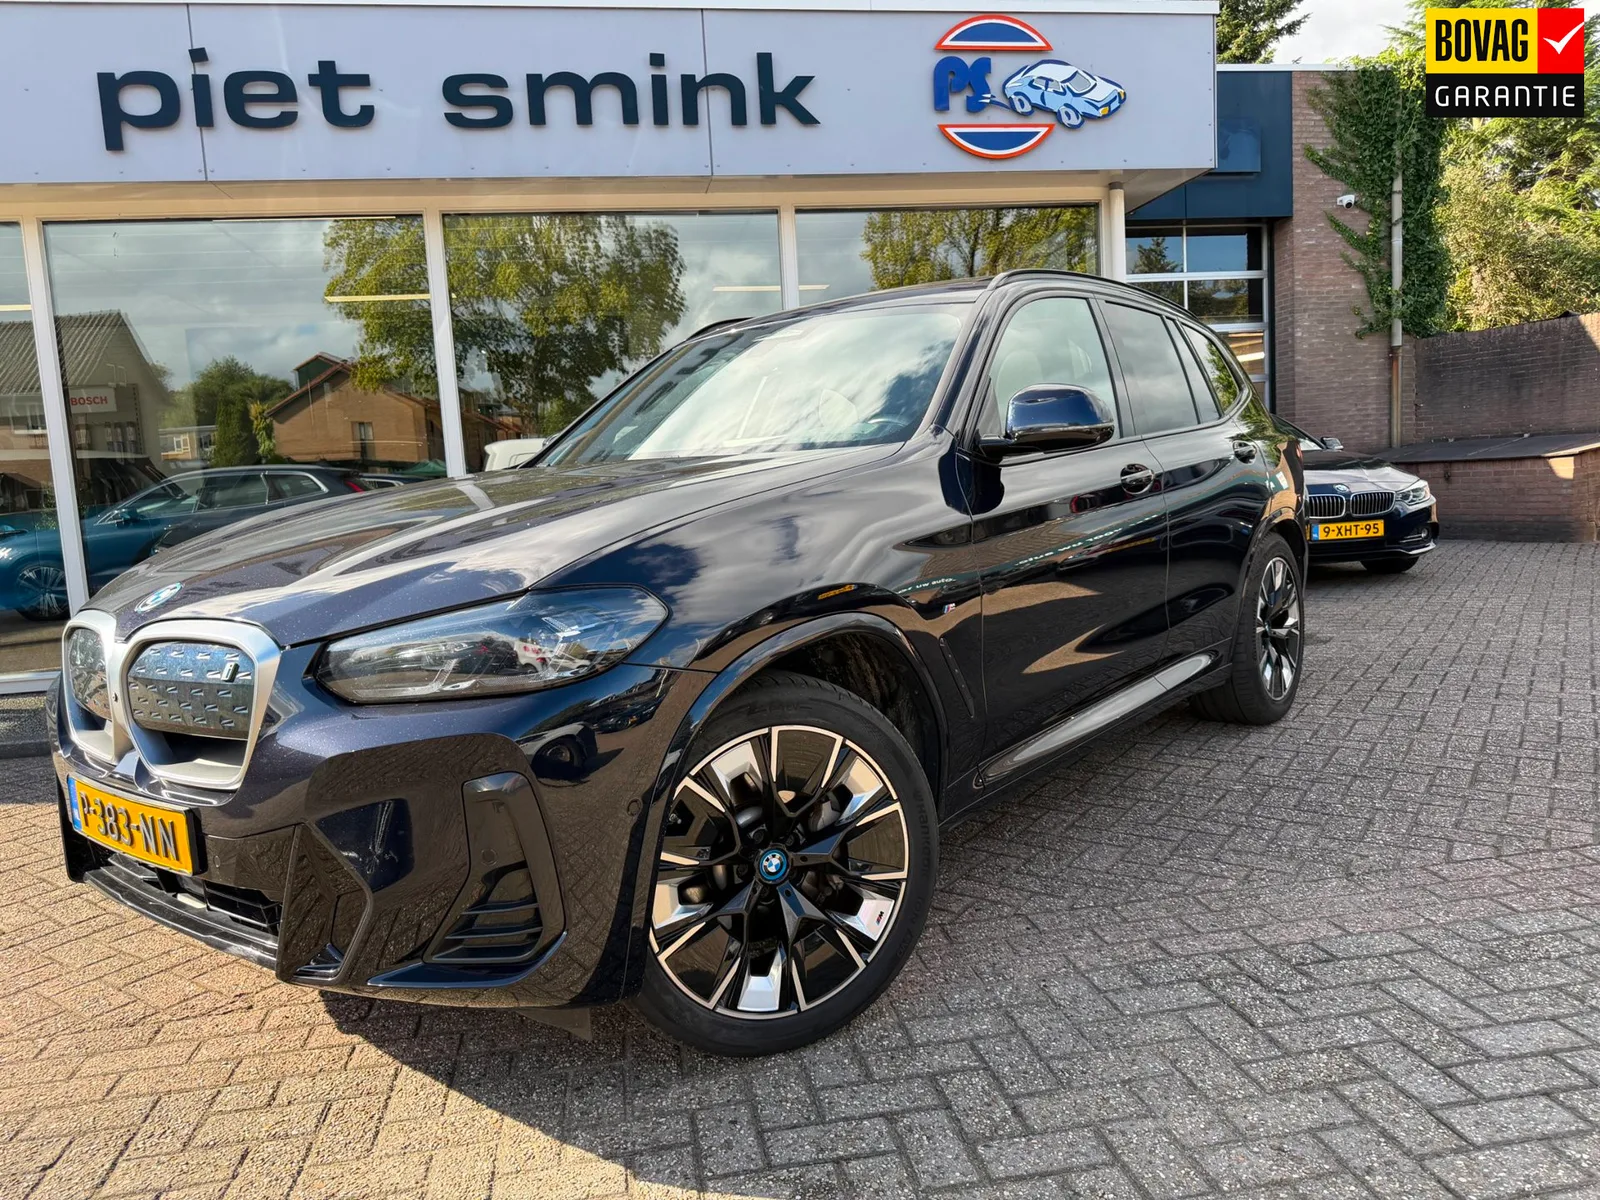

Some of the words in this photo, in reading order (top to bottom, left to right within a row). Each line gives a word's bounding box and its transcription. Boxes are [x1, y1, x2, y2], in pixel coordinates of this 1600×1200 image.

[97, 47, 375, 151] piet
[442, 52, 821, 129] smink
[933, 55, 992, 113] PS
[71, 396, 108, 406] BOSCH
[1323, 523, 1380, 537] 9-XHT-95
[79, 791, 180, 862] P-383-NN
